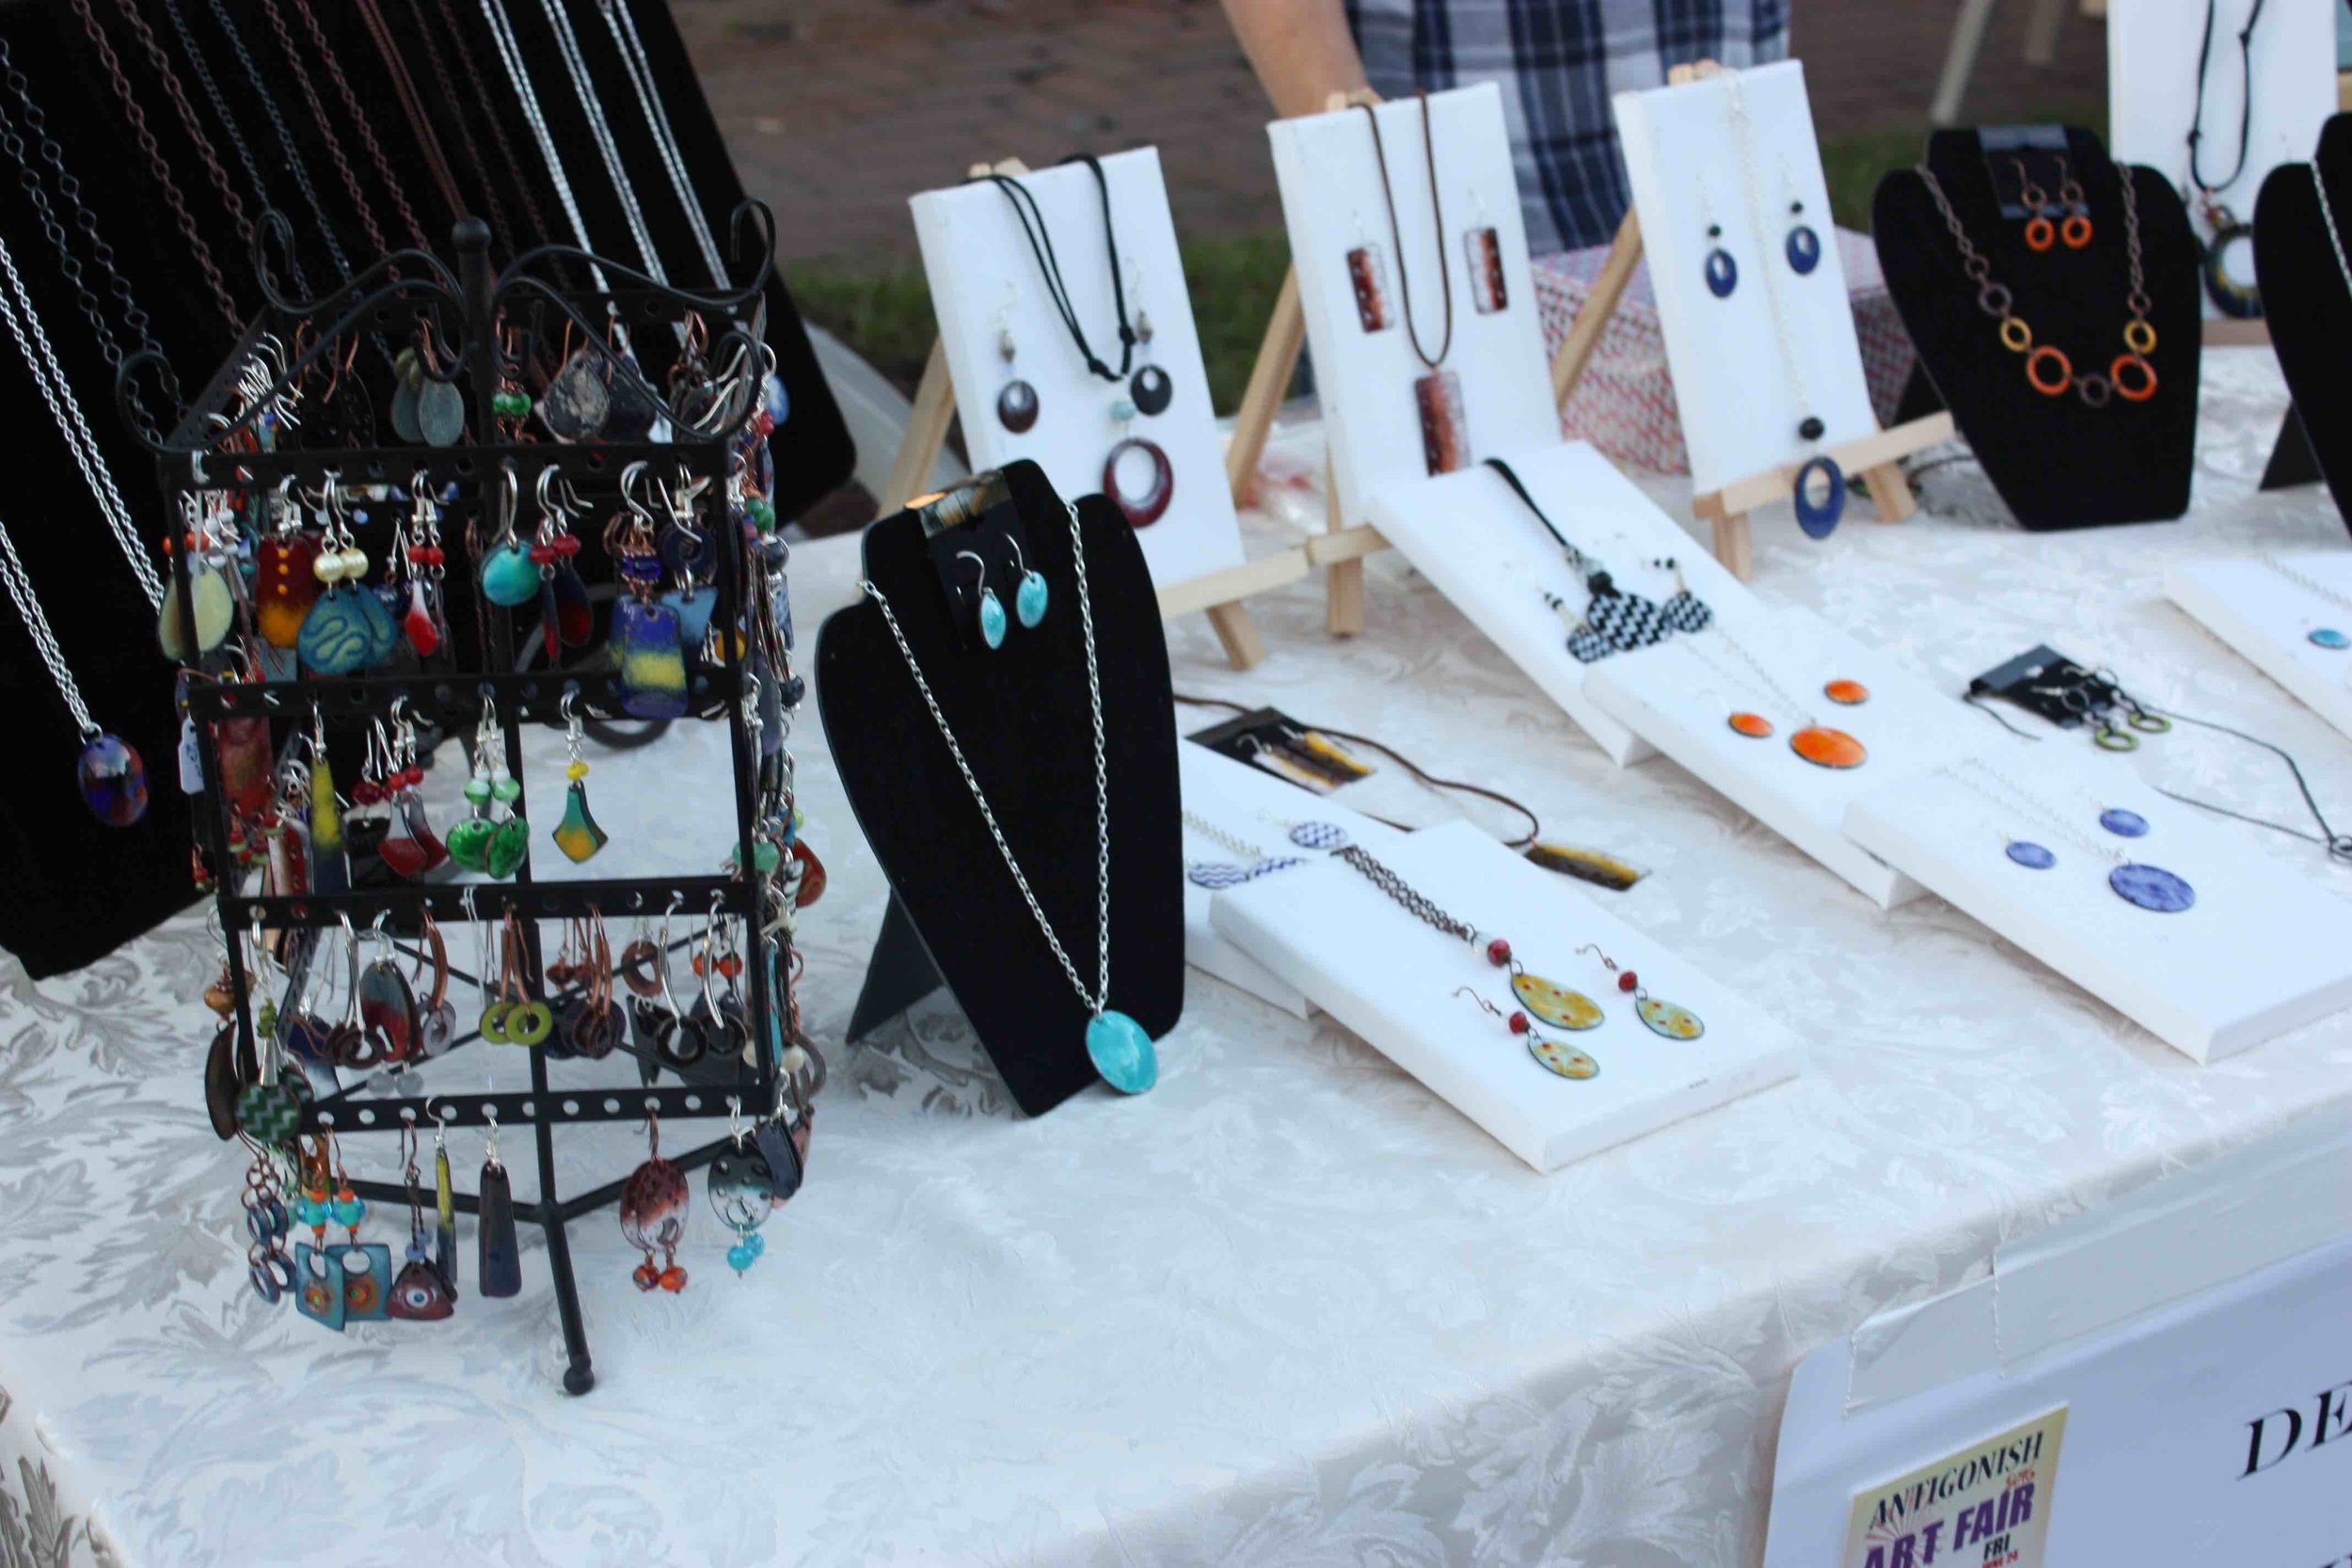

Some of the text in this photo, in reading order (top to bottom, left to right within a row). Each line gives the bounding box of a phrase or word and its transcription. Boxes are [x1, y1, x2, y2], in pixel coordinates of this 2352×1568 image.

[1868, 1430, 2044, 1531] ANTIGONISH
[1952, 1481, 2036, 1553] FAIR
[1983, 1532, 2010, 1561] FRI
